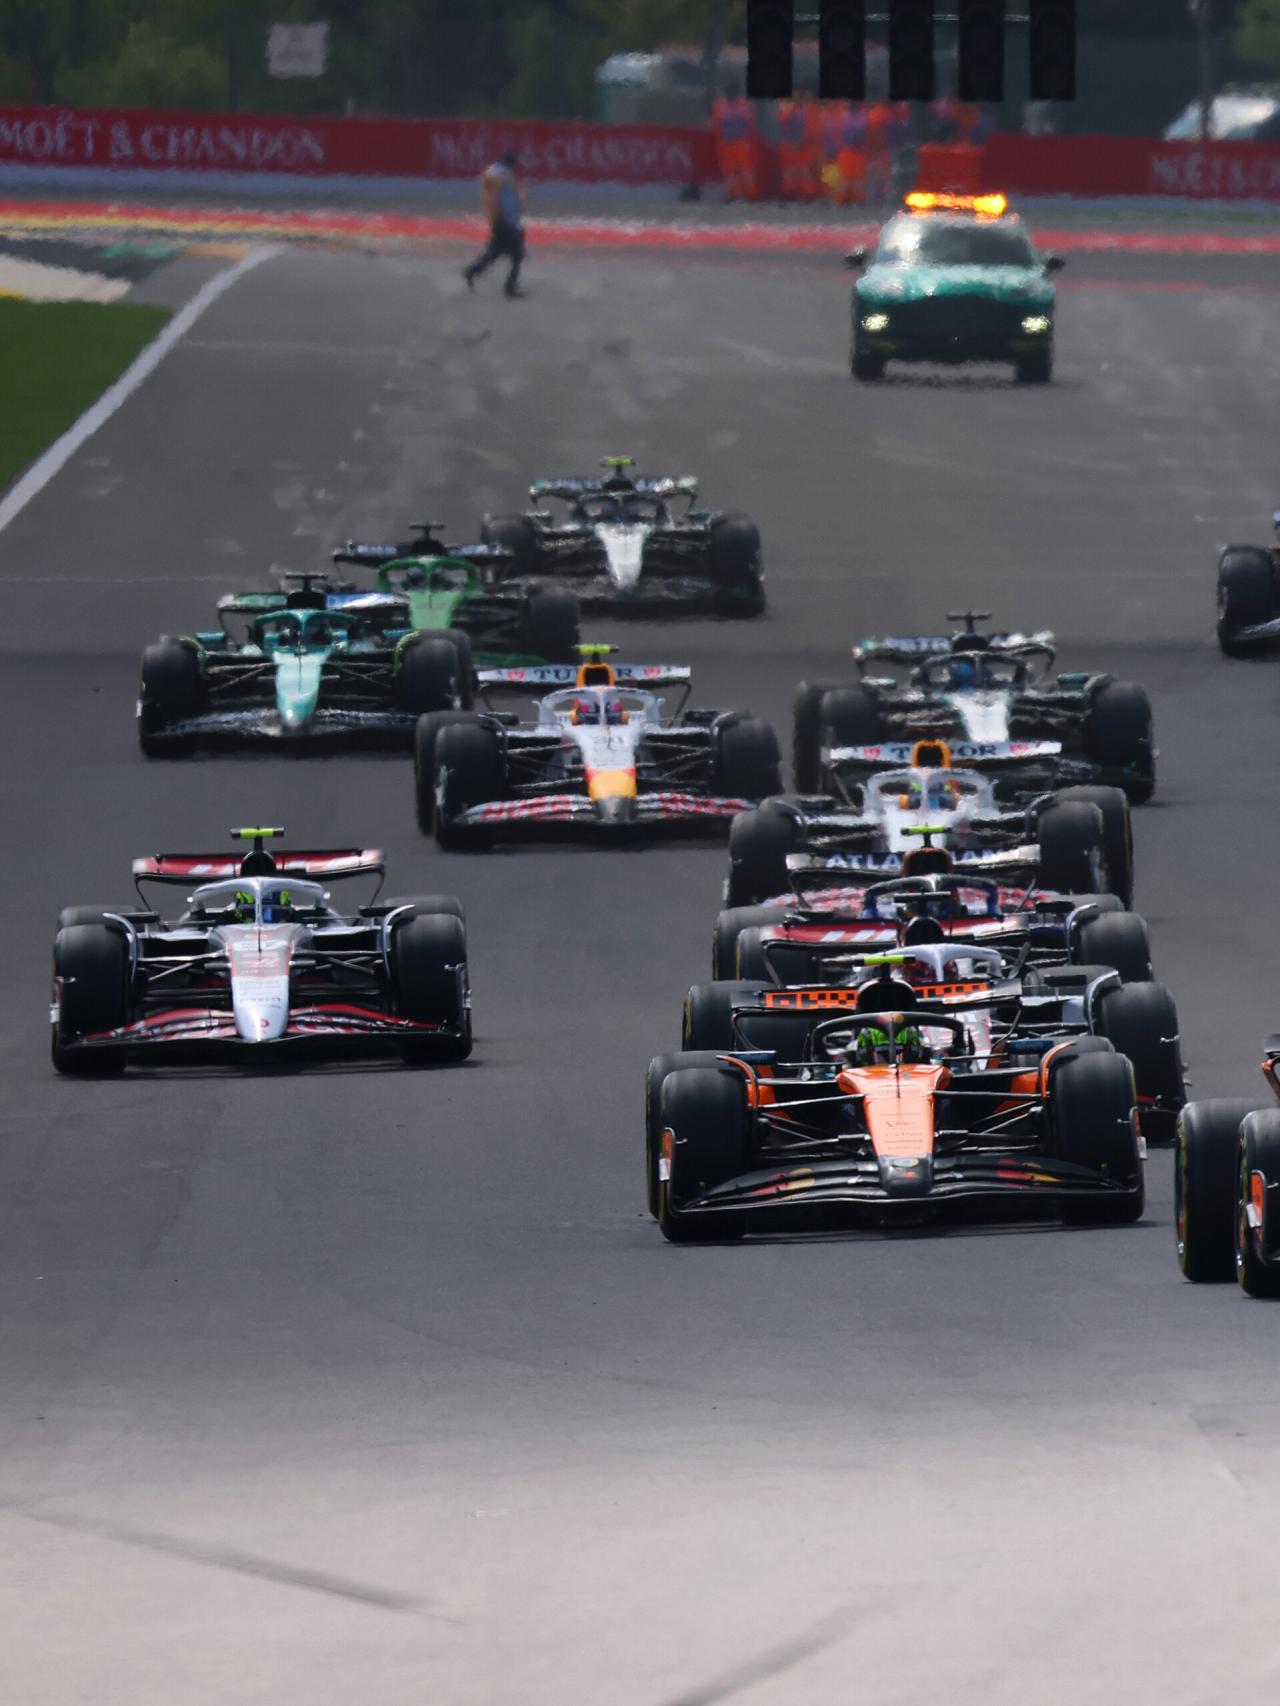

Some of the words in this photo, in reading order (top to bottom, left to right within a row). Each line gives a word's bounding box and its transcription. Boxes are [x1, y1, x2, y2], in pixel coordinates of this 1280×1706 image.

[0, 104, 99, 158] MOËT
[110, 120, 134, 158] &
[140, 126, 326, 164] CHANDON
